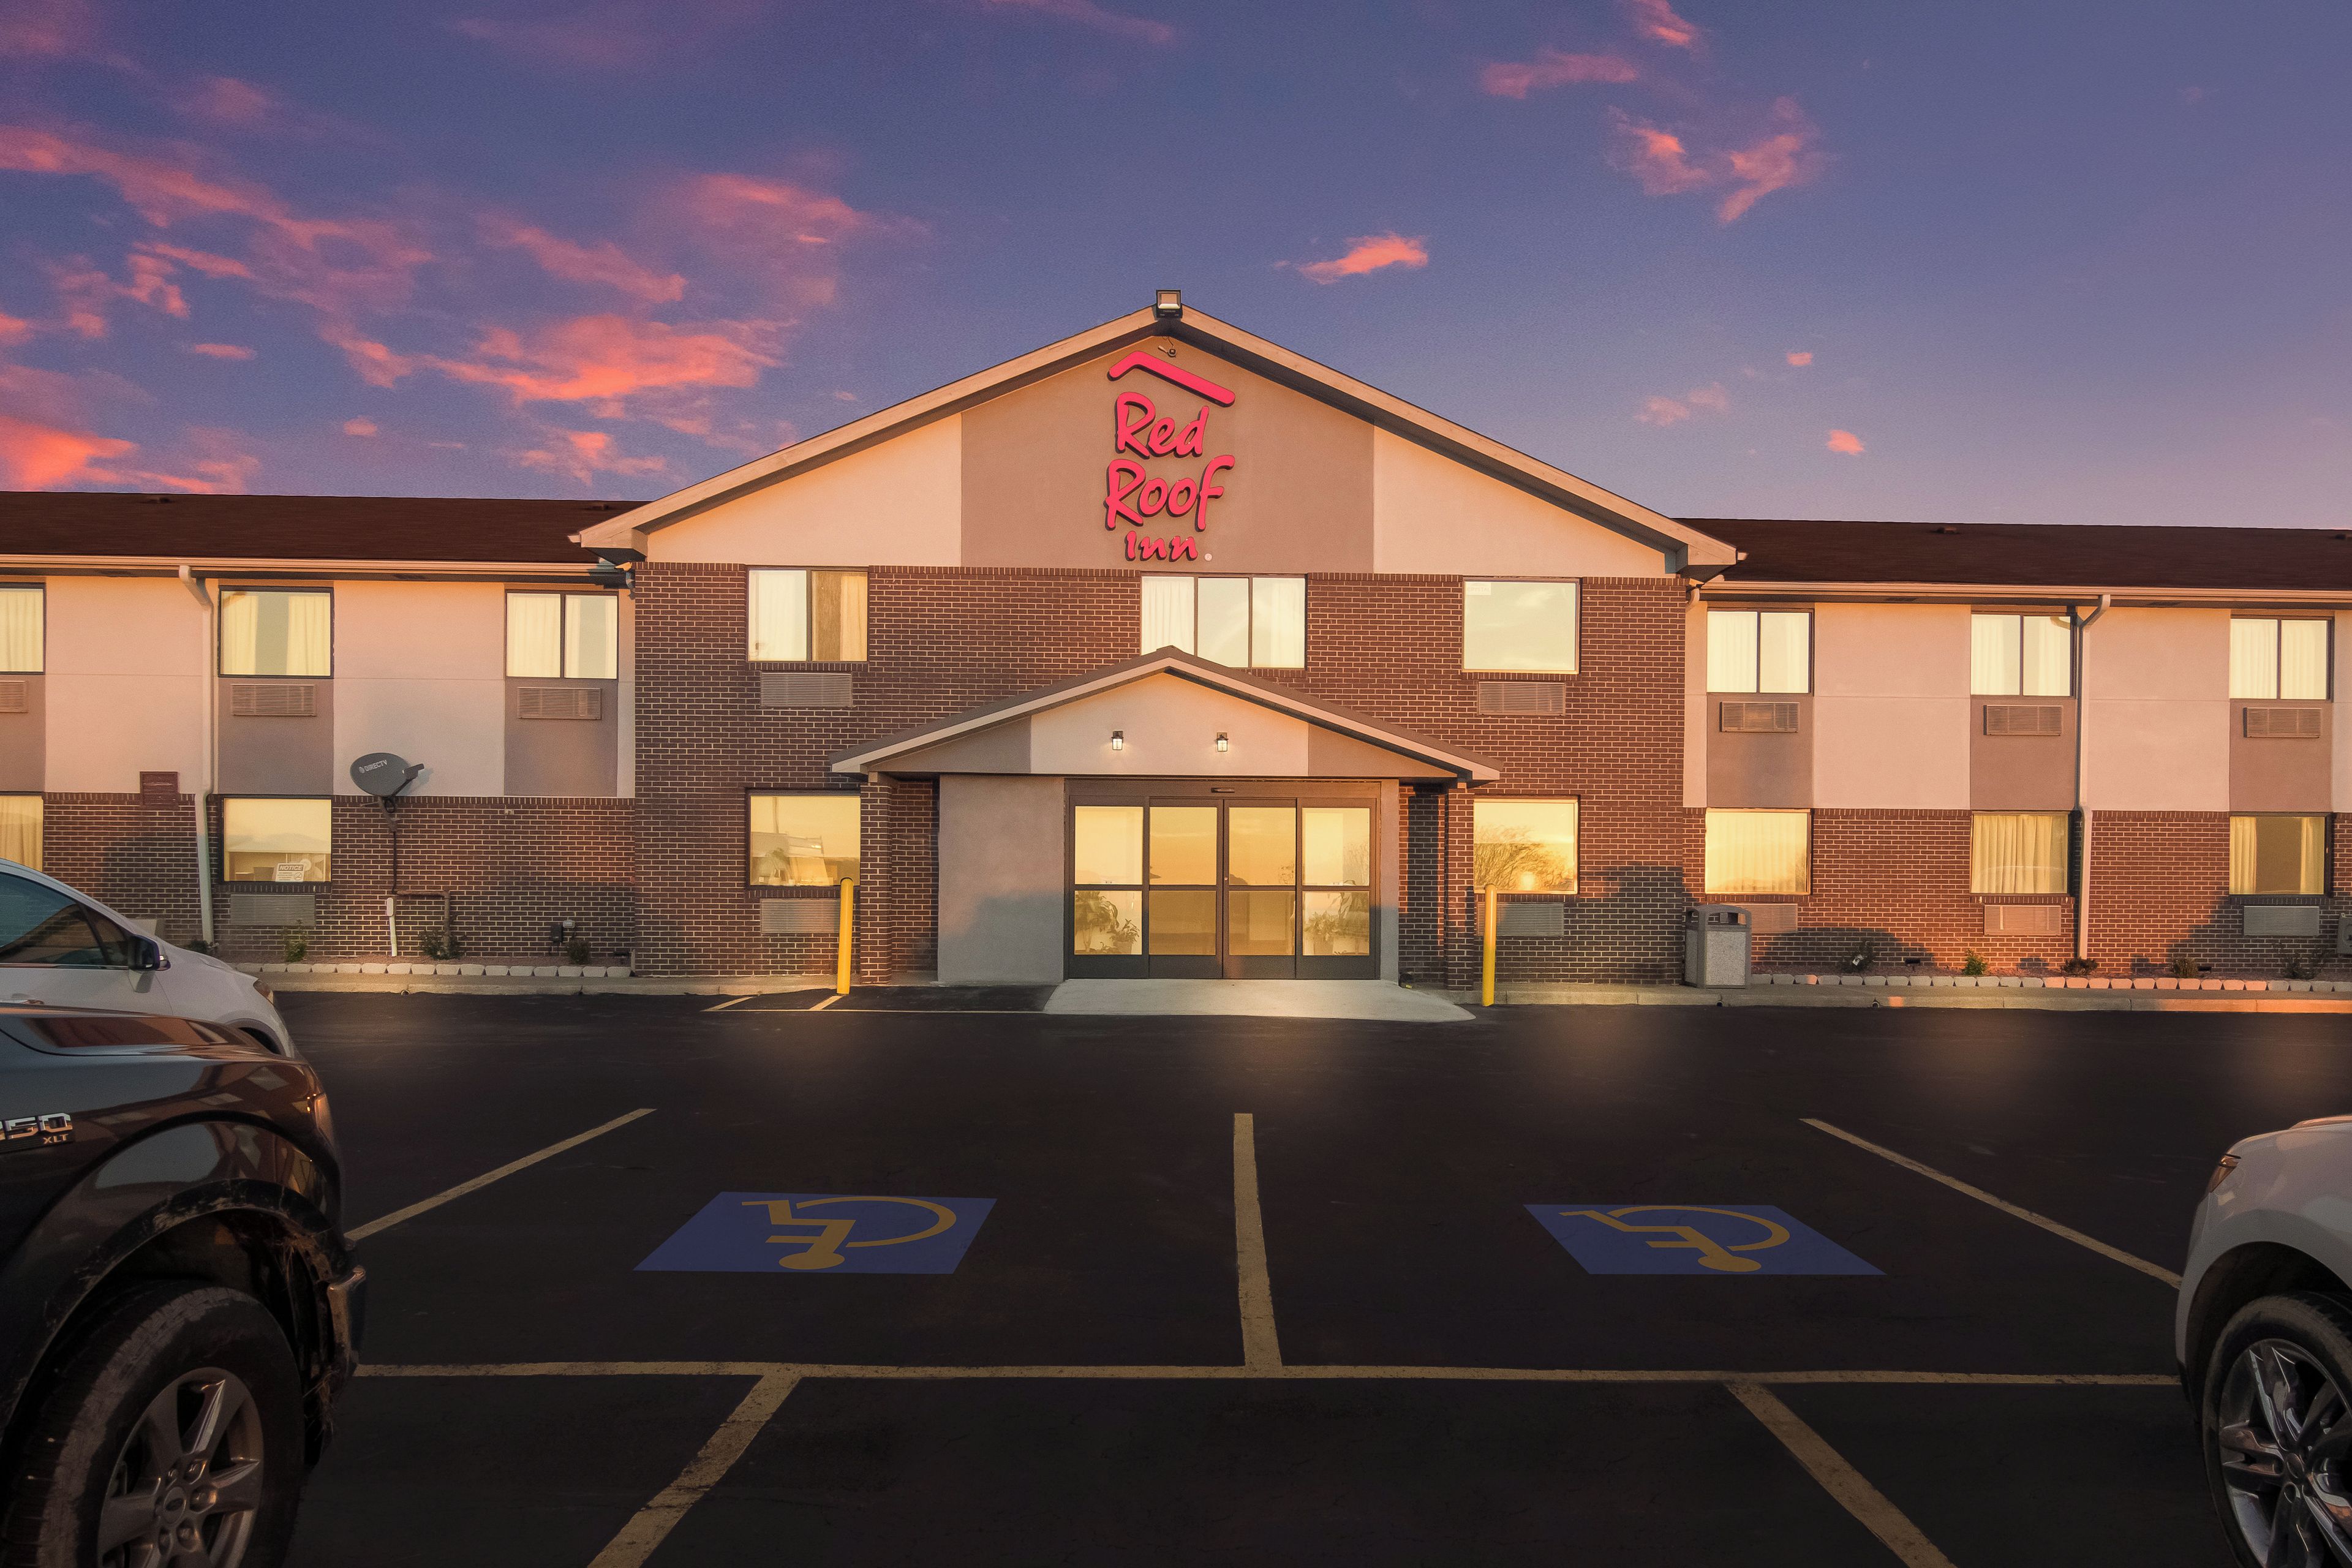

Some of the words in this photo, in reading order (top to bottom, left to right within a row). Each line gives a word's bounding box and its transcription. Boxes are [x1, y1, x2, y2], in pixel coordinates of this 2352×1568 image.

[1115, 392, 1209, 459] Red
[1104, 455, 1235, 532] Roof
[364, 759, 388, 772] DIRECTV
[43, 1133, 69, 1144] XLT
